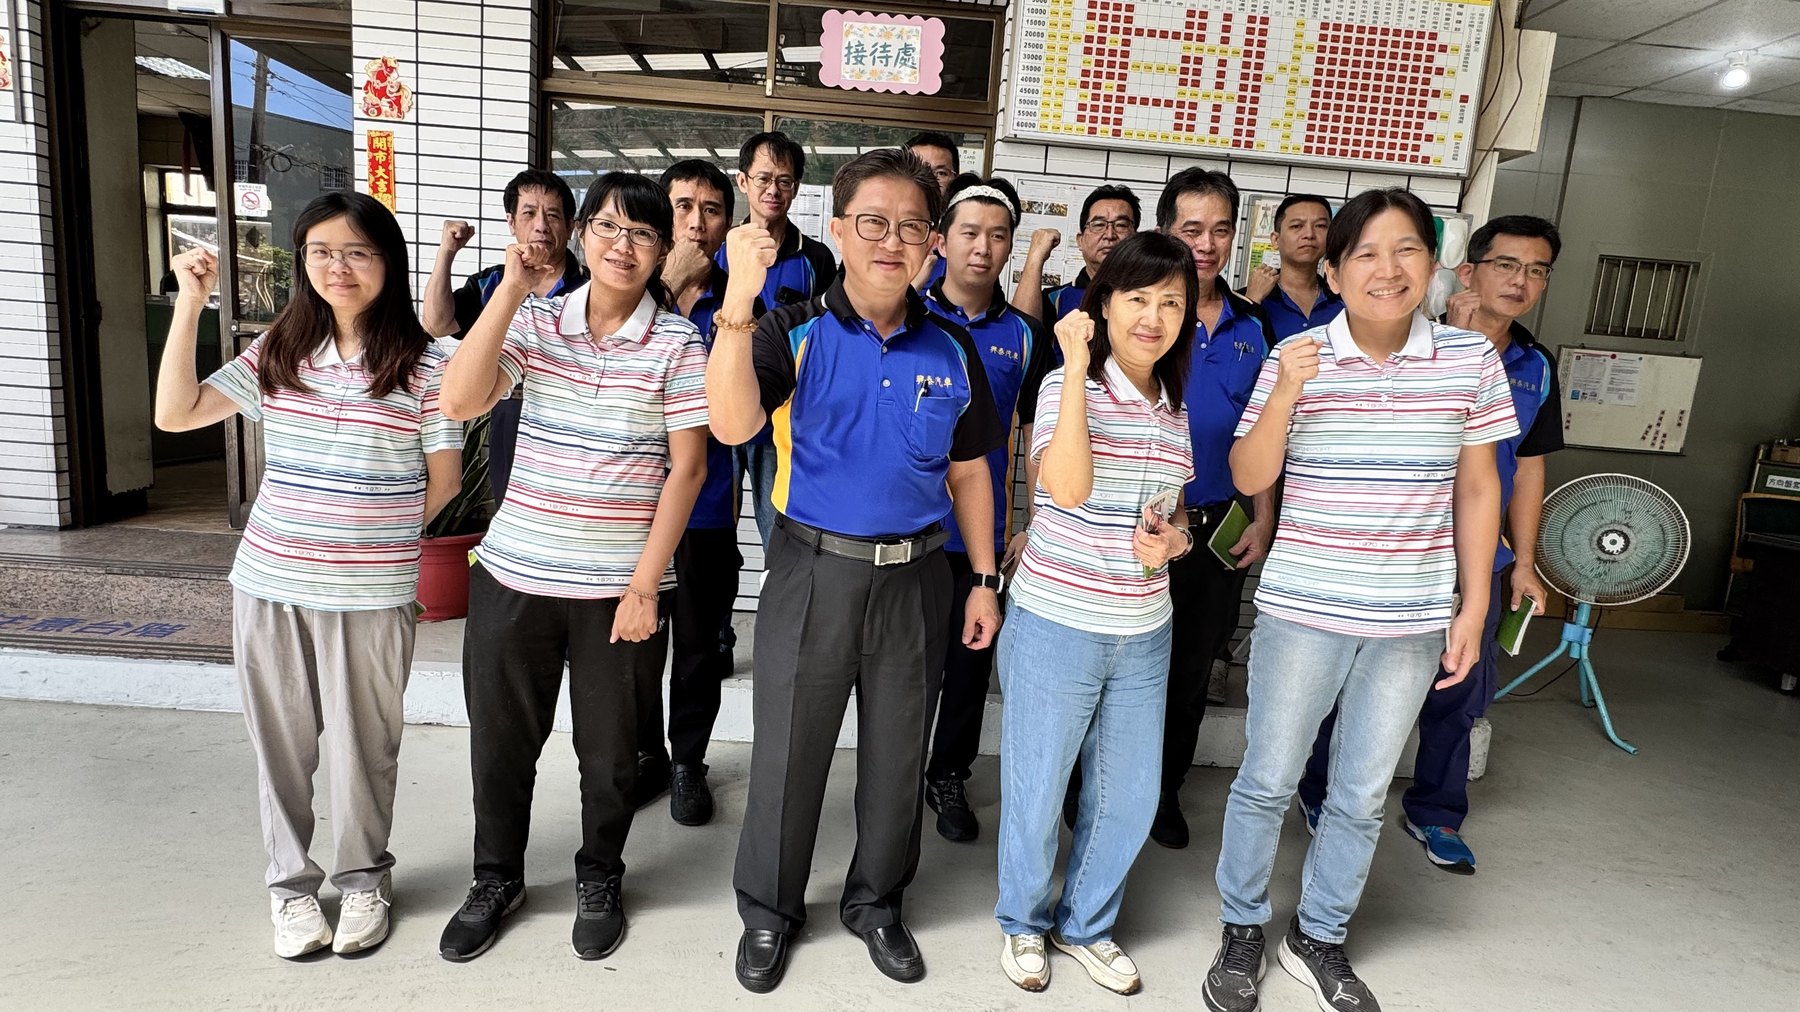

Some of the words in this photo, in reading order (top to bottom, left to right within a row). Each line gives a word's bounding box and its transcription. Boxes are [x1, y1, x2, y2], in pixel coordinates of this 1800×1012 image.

[1026, 7, 1047, 16] 10000
[1026, 19, 1046, 27] 15000
[1024, 30, 1045, 39] 20000
[1023, 41, 1044, 50] 25000
[844, 40, 917, 69] 接待處
[1022, 53, 1043, 61] 30000
[1021, 64, 1041, 72] 35000
[1020, 76, 1040, 84] 40000
[1019, 87, 1039, 95] 45000
[1018, 98, 1038, 106] 50000
[1017, 110, 1037, 118] 55000
[1016, 121, 1036, 129] 60000
[372, 136, 389, 193] 開市大吉
